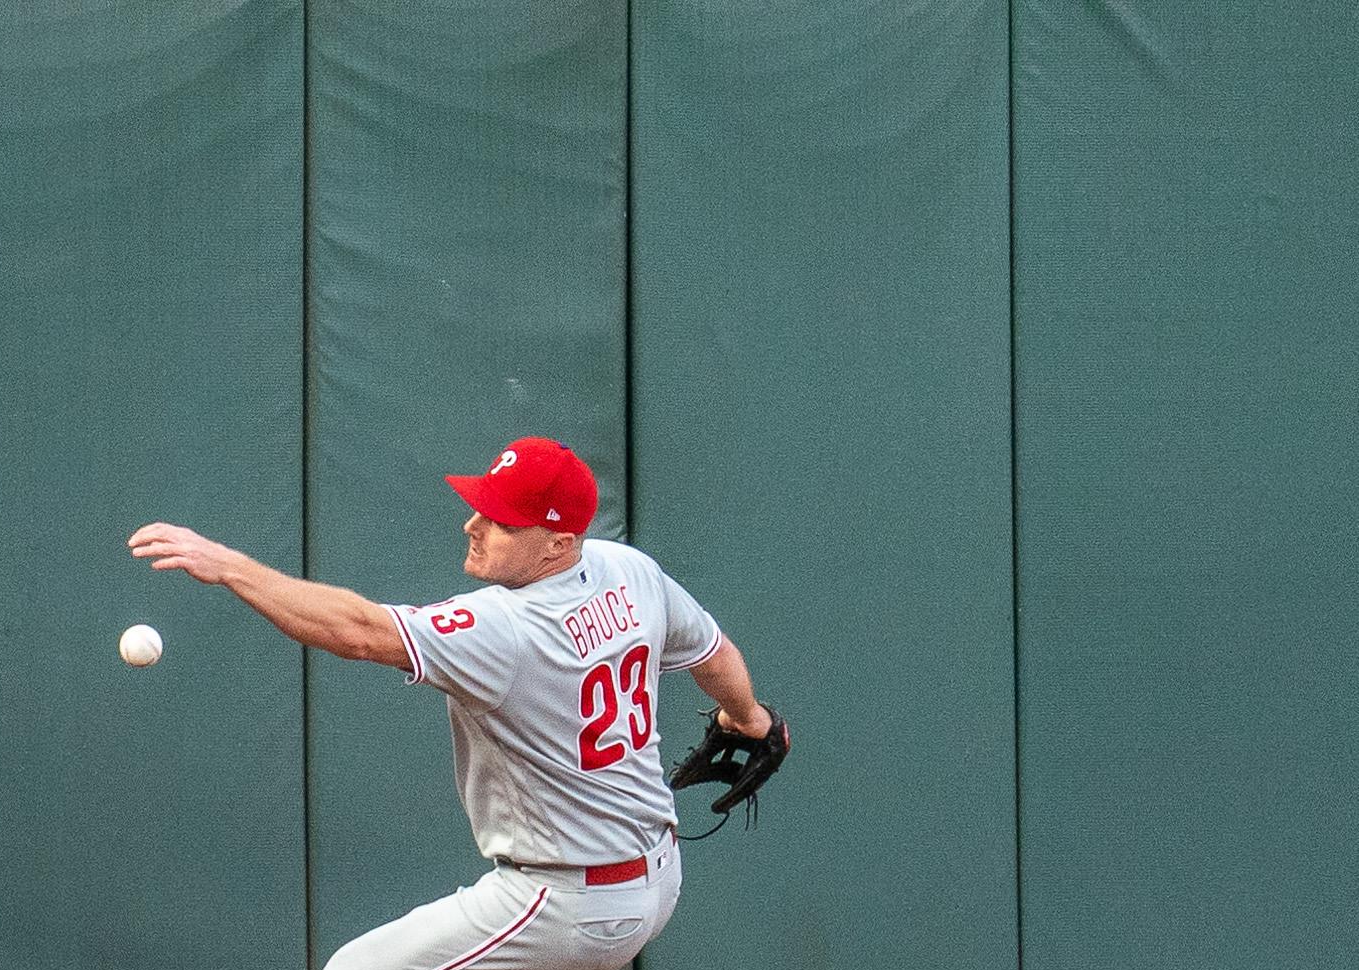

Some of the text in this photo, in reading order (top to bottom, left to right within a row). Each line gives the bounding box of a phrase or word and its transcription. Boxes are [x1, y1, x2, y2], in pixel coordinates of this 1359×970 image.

[491, 450, 518, 475] P
[428, 600, 475, 635] 3
[564, 585, 640, 660] BRUCE
[578, 643, 652, 772] 23
